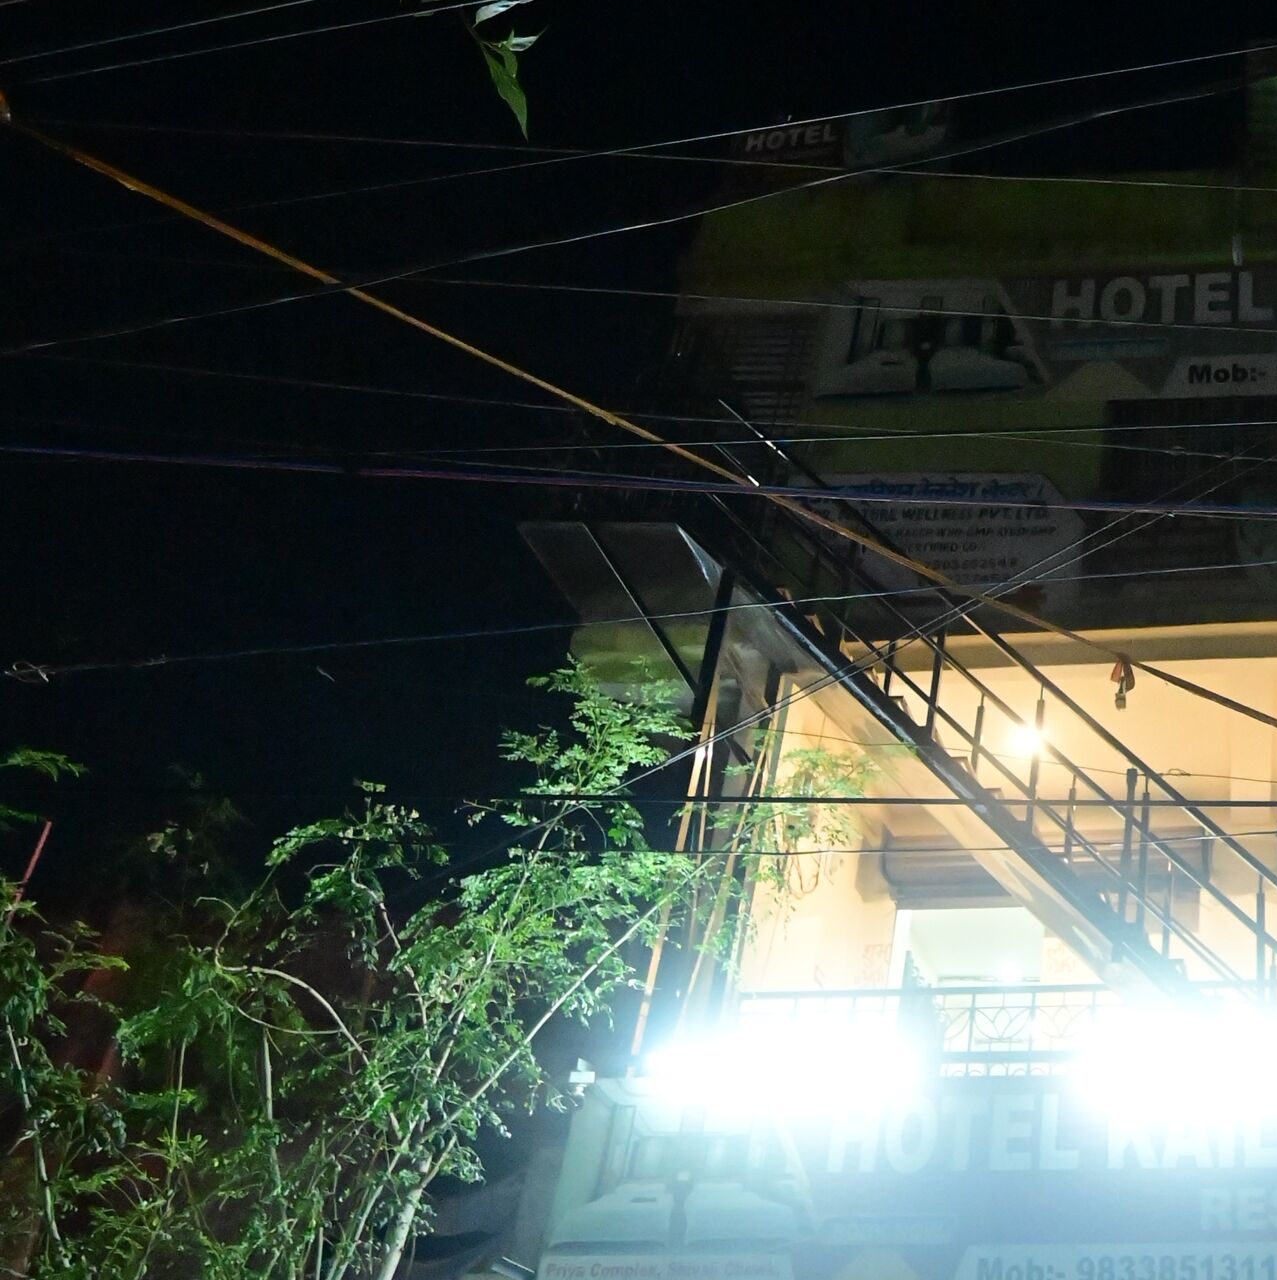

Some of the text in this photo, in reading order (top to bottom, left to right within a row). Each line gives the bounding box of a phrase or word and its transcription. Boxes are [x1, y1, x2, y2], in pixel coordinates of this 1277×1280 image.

[744, 123, 838, 153] HOTEL
[1050, 271, 1274, 328] HOTEL
[826, 1089, 1081, 1174] HOTEL
[545, 1262, 585, 1279] Priya
